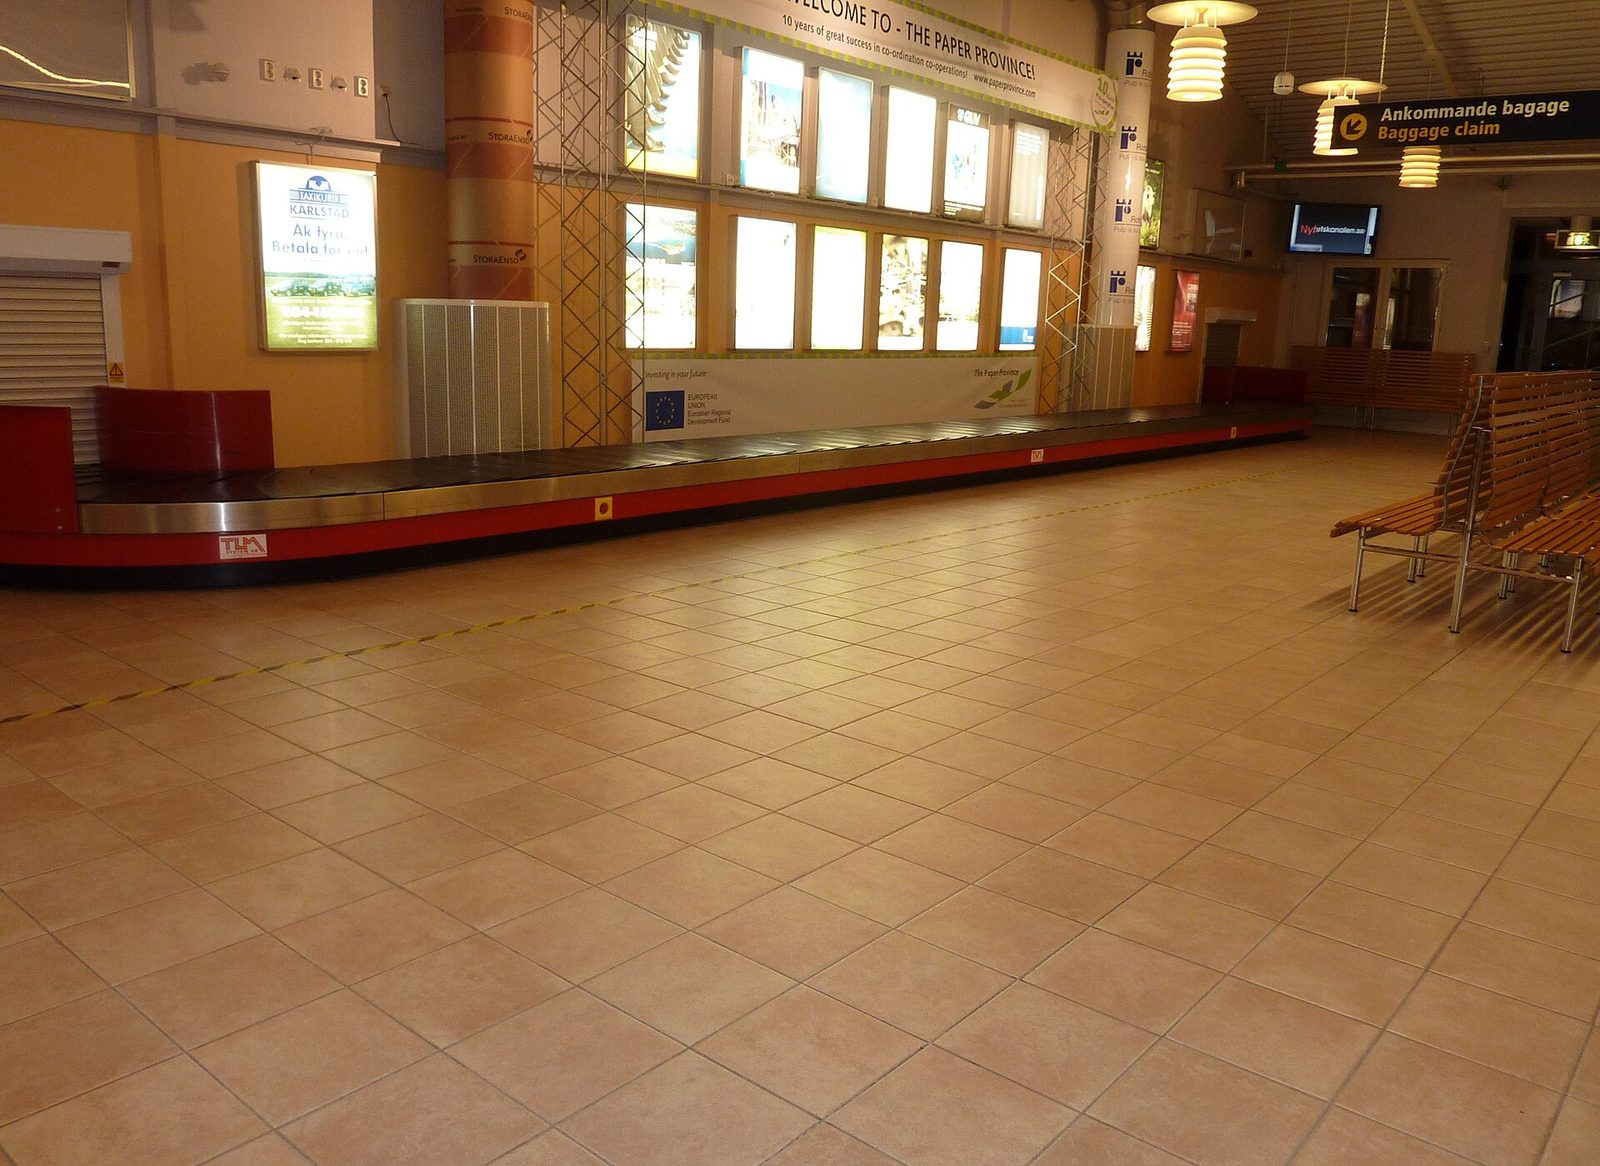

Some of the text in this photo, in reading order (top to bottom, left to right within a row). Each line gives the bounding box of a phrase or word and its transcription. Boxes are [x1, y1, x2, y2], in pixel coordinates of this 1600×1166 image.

[788, 0, 867, 26] LCOME
[871, 9, 892, 33] TO
[905, 21, 931, 47] THE
[935, 31, 972, 60] PAPER
[975, 45, 1036, 80] PROVINCE!
[782, 14, 1037, 98] 10 years of great success in co-ordination co-operations! www.paperprovince.com
[1380, 99, 1570, 122] Ankommande bagage
[1377, 121, 1500, 143] Baggage claim
[289, 205, 350, 218] KARLSTAD
[272, 240, 319, 255] Betala
[677, 371, 689, 380] your
[689, 368, 707, 380] future
[974, 368, 1020, 379] The Paper Province
[688, 409, 732, 418] European Regional
[688, 416, 731, 426] Development Fund
